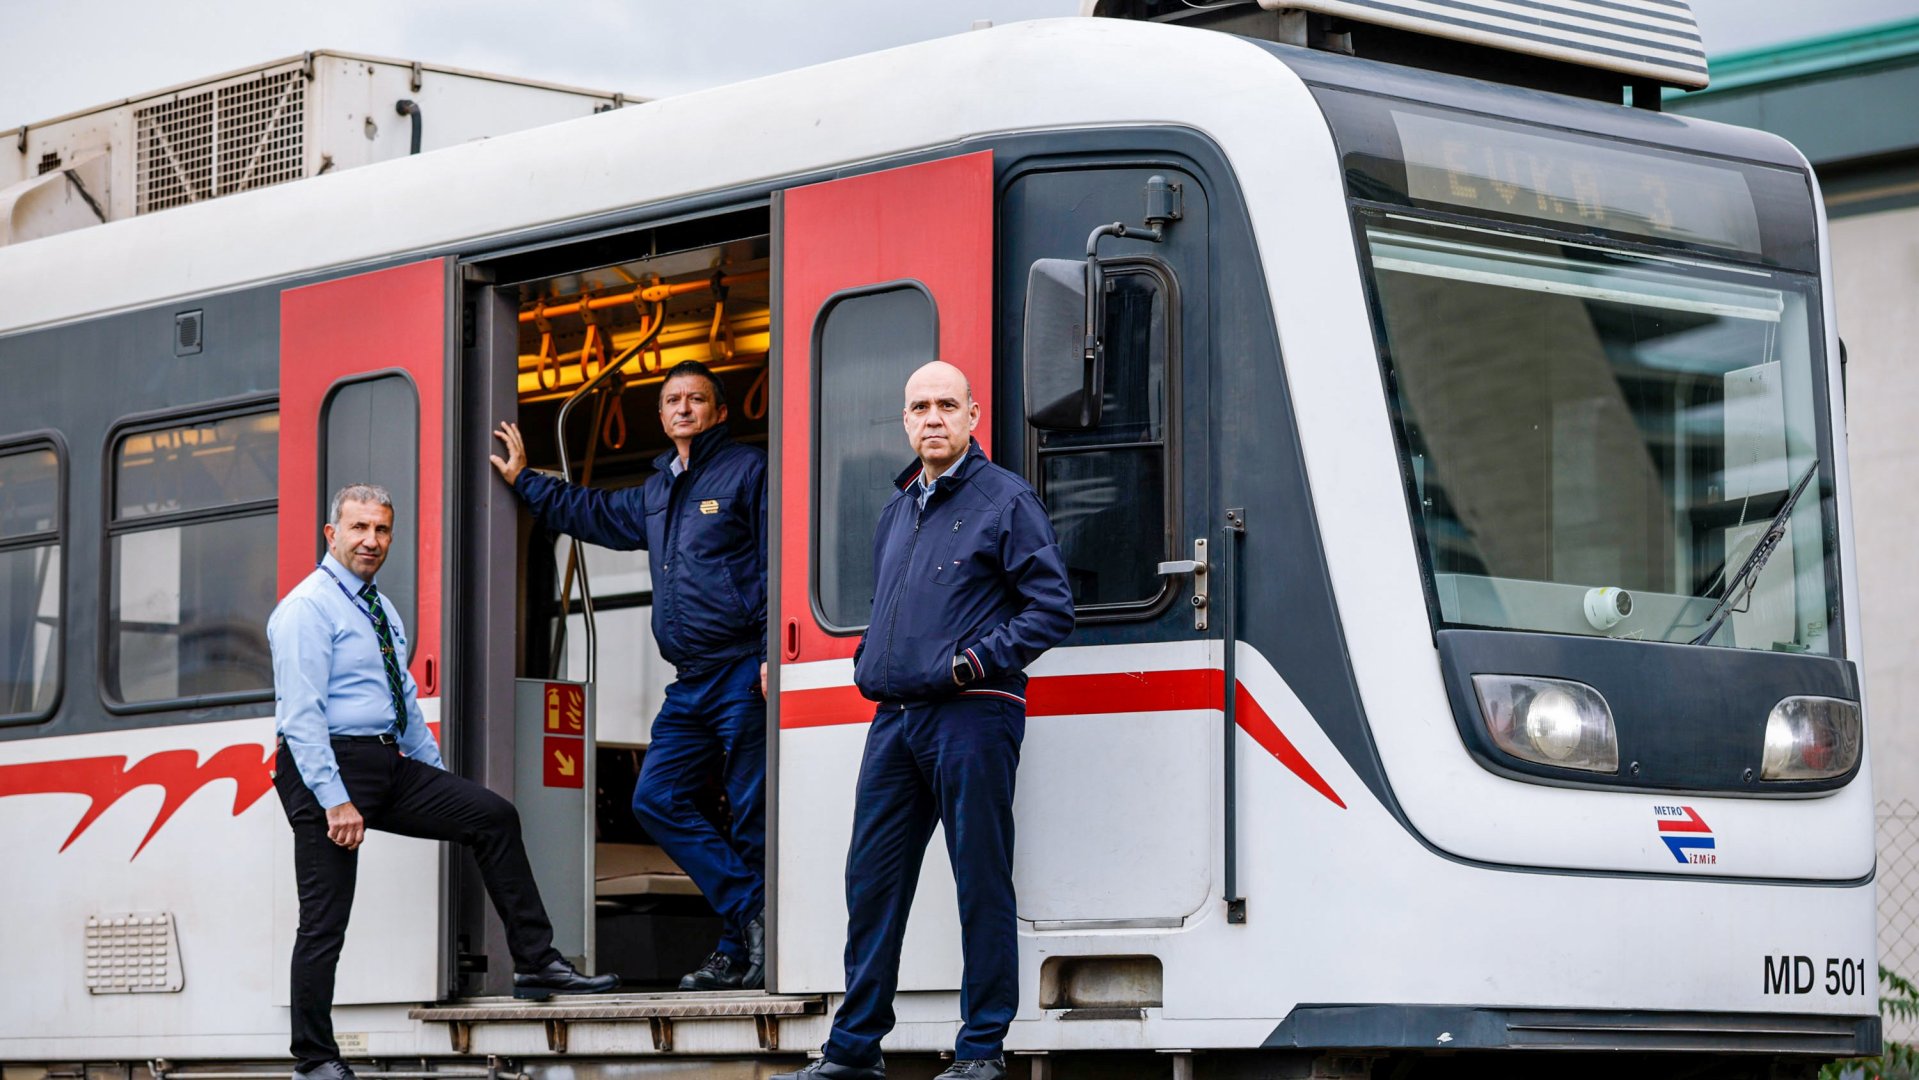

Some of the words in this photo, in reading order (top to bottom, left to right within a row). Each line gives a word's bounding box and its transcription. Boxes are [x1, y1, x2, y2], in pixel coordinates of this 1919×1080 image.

[1443, 142, 1604, 220] EVKA
[1641, 175, 1673, 231] 3
[1654, 806, 1682, 816] METRO
[1764, 955, 1814, 994] MD
[1825, 958, 1864, 995] 501
